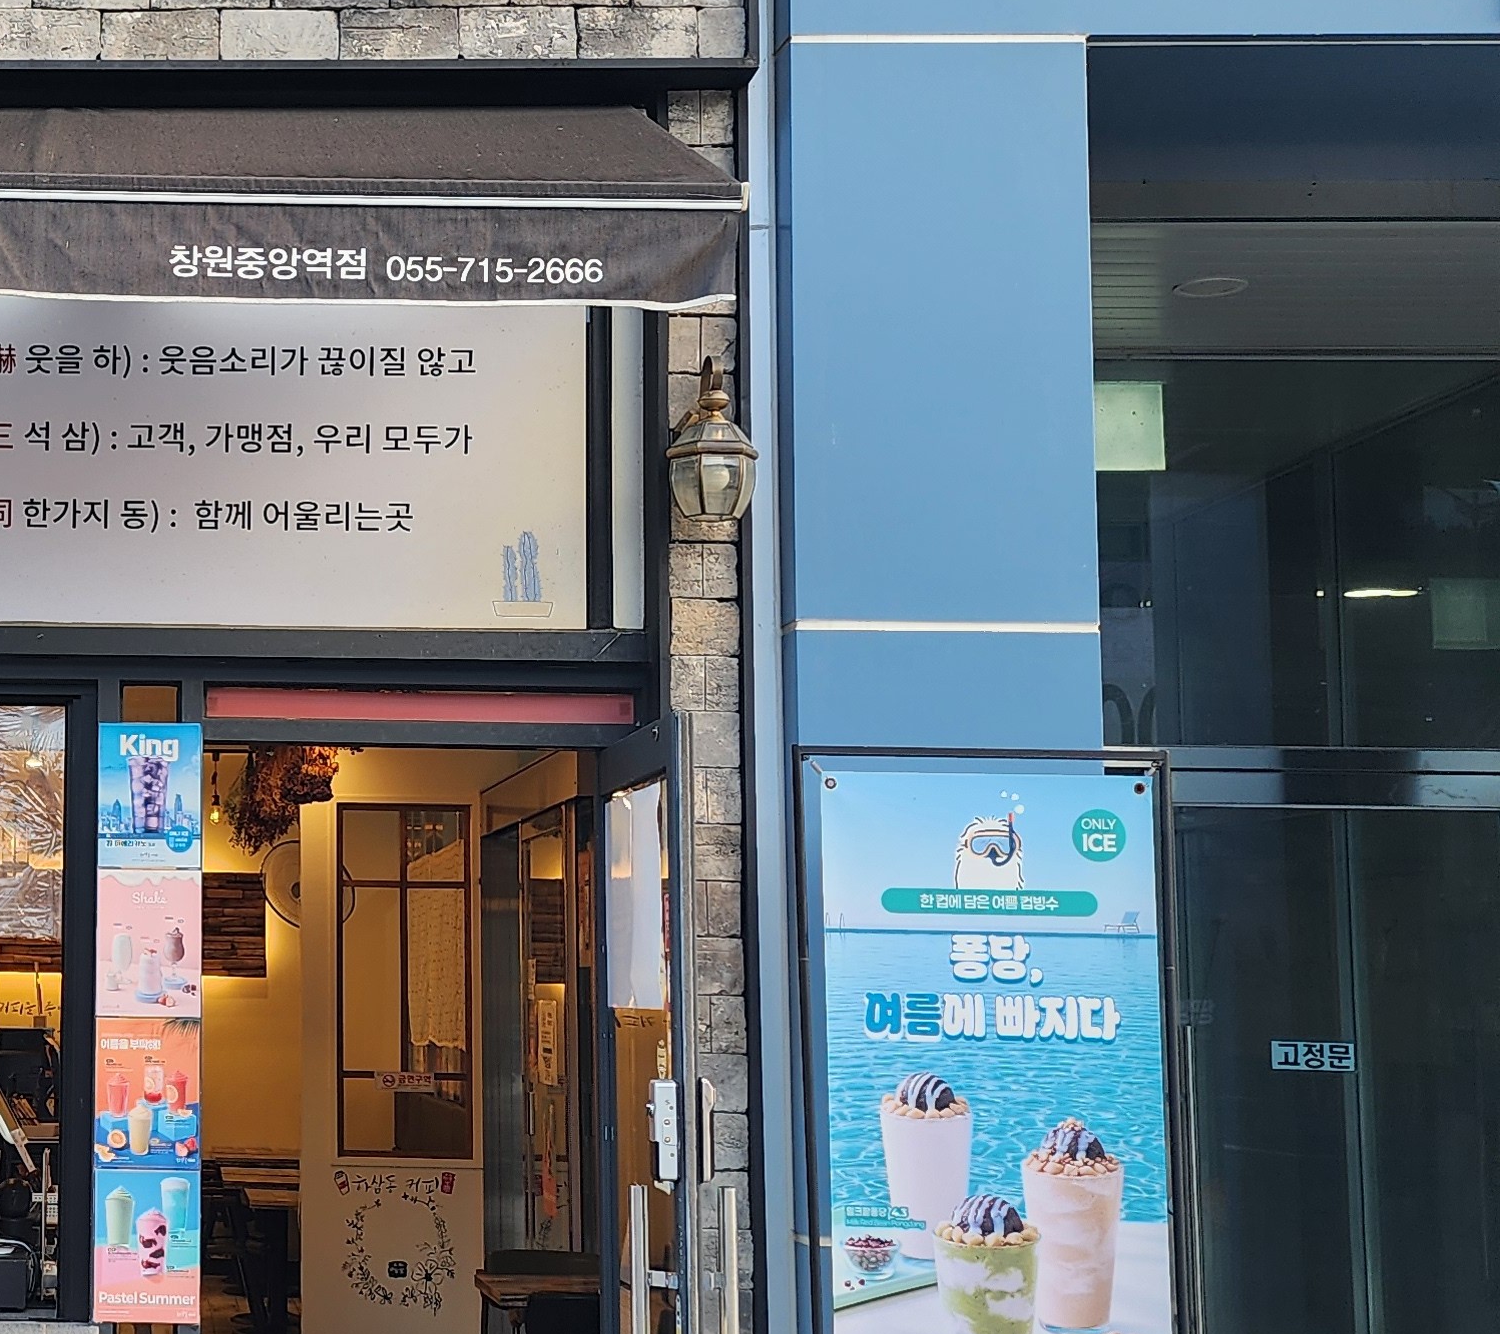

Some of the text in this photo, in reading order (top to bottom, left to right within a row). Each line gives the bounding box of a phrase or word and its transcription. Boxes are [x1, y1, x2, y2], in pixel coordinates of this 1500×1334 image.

[168, 244, 603, 285] 창원중앙역점 055-715-2666
[25, 345, 83, 375] 웃을
[93, 345, 131, 378] 하)
[159, 345, 309, 376] 웃음소리가
[318, 346, 406, 377] 끊이질
[417, 347, 476, 377] 않고
[24, 421, 50, 451] 석
[62, 421, 100, 455] 삼)
[127, 422, 195, 457] 고객,
[205, 422, 304, 457] 가맹점,
[313, 423, 371, 454] 우리
[382, 423, 473, 455] 모두가
[22, 498, 109, 529] 한가지
[120, 499, 159, 533] 동)
[194, 499, 251, 531] 함께
[263, 500, 414, 532] 어울리는곳
[120, 734, 179, 762] King
[1081, 818, 1117, 831] ONLY
[1082, 833, 1117, 853] ICE
[132, 889, 168, 905] Shake
[920, 893, 1060, 911] 한 컵에 담은 여름 컵빙수
[949, 934, 1043, 987] 퐁당,
[864, 992, 986, 1042] 여름에
[995, 995, 1121, 1042] 빠지다
[1277, 1043, 1351, 1069] 고정문
[398, 1074, 431, 1084] 금연구역
[351, 1174, 397, 1194] 하삼동
[99, 1291, 196, 1305] Pastel Summer
